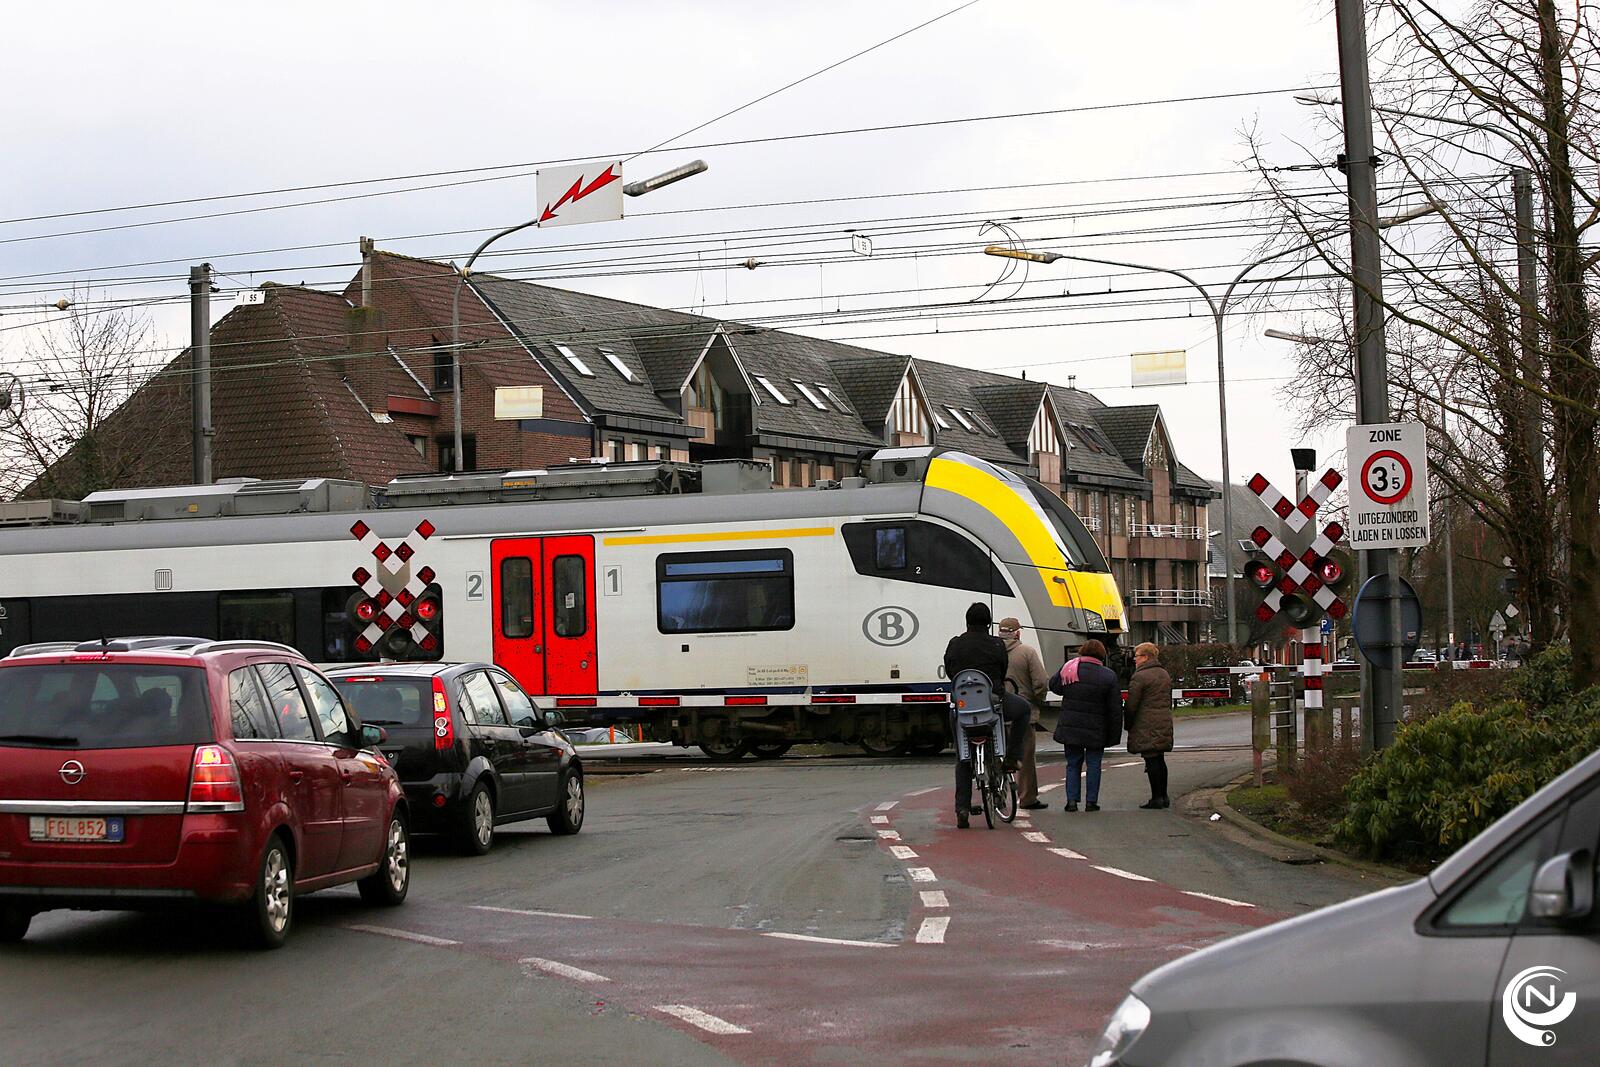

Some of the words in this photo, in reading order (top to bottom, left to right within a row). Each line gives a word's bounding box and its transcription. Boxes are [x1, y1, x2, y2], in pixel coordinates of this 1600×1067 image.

[1369, 429, 1402, 442] ZONE
[1391, 462, 1396, 471] t
[1358, 510, 1418, 525] UITGEZONDERD
[1352, 529, 1379, 542] LADEN
[1382, 528, 1393, 540] EN
[1395, 526, 1427, 540] LOSSEN
[915, 566, 921, 575] 2
[468, 574, 482, 598] 2
[607, 568, 618, 593] 1
[1321, 619, 1328, 629] P
[111, 823, 119, 833] B
